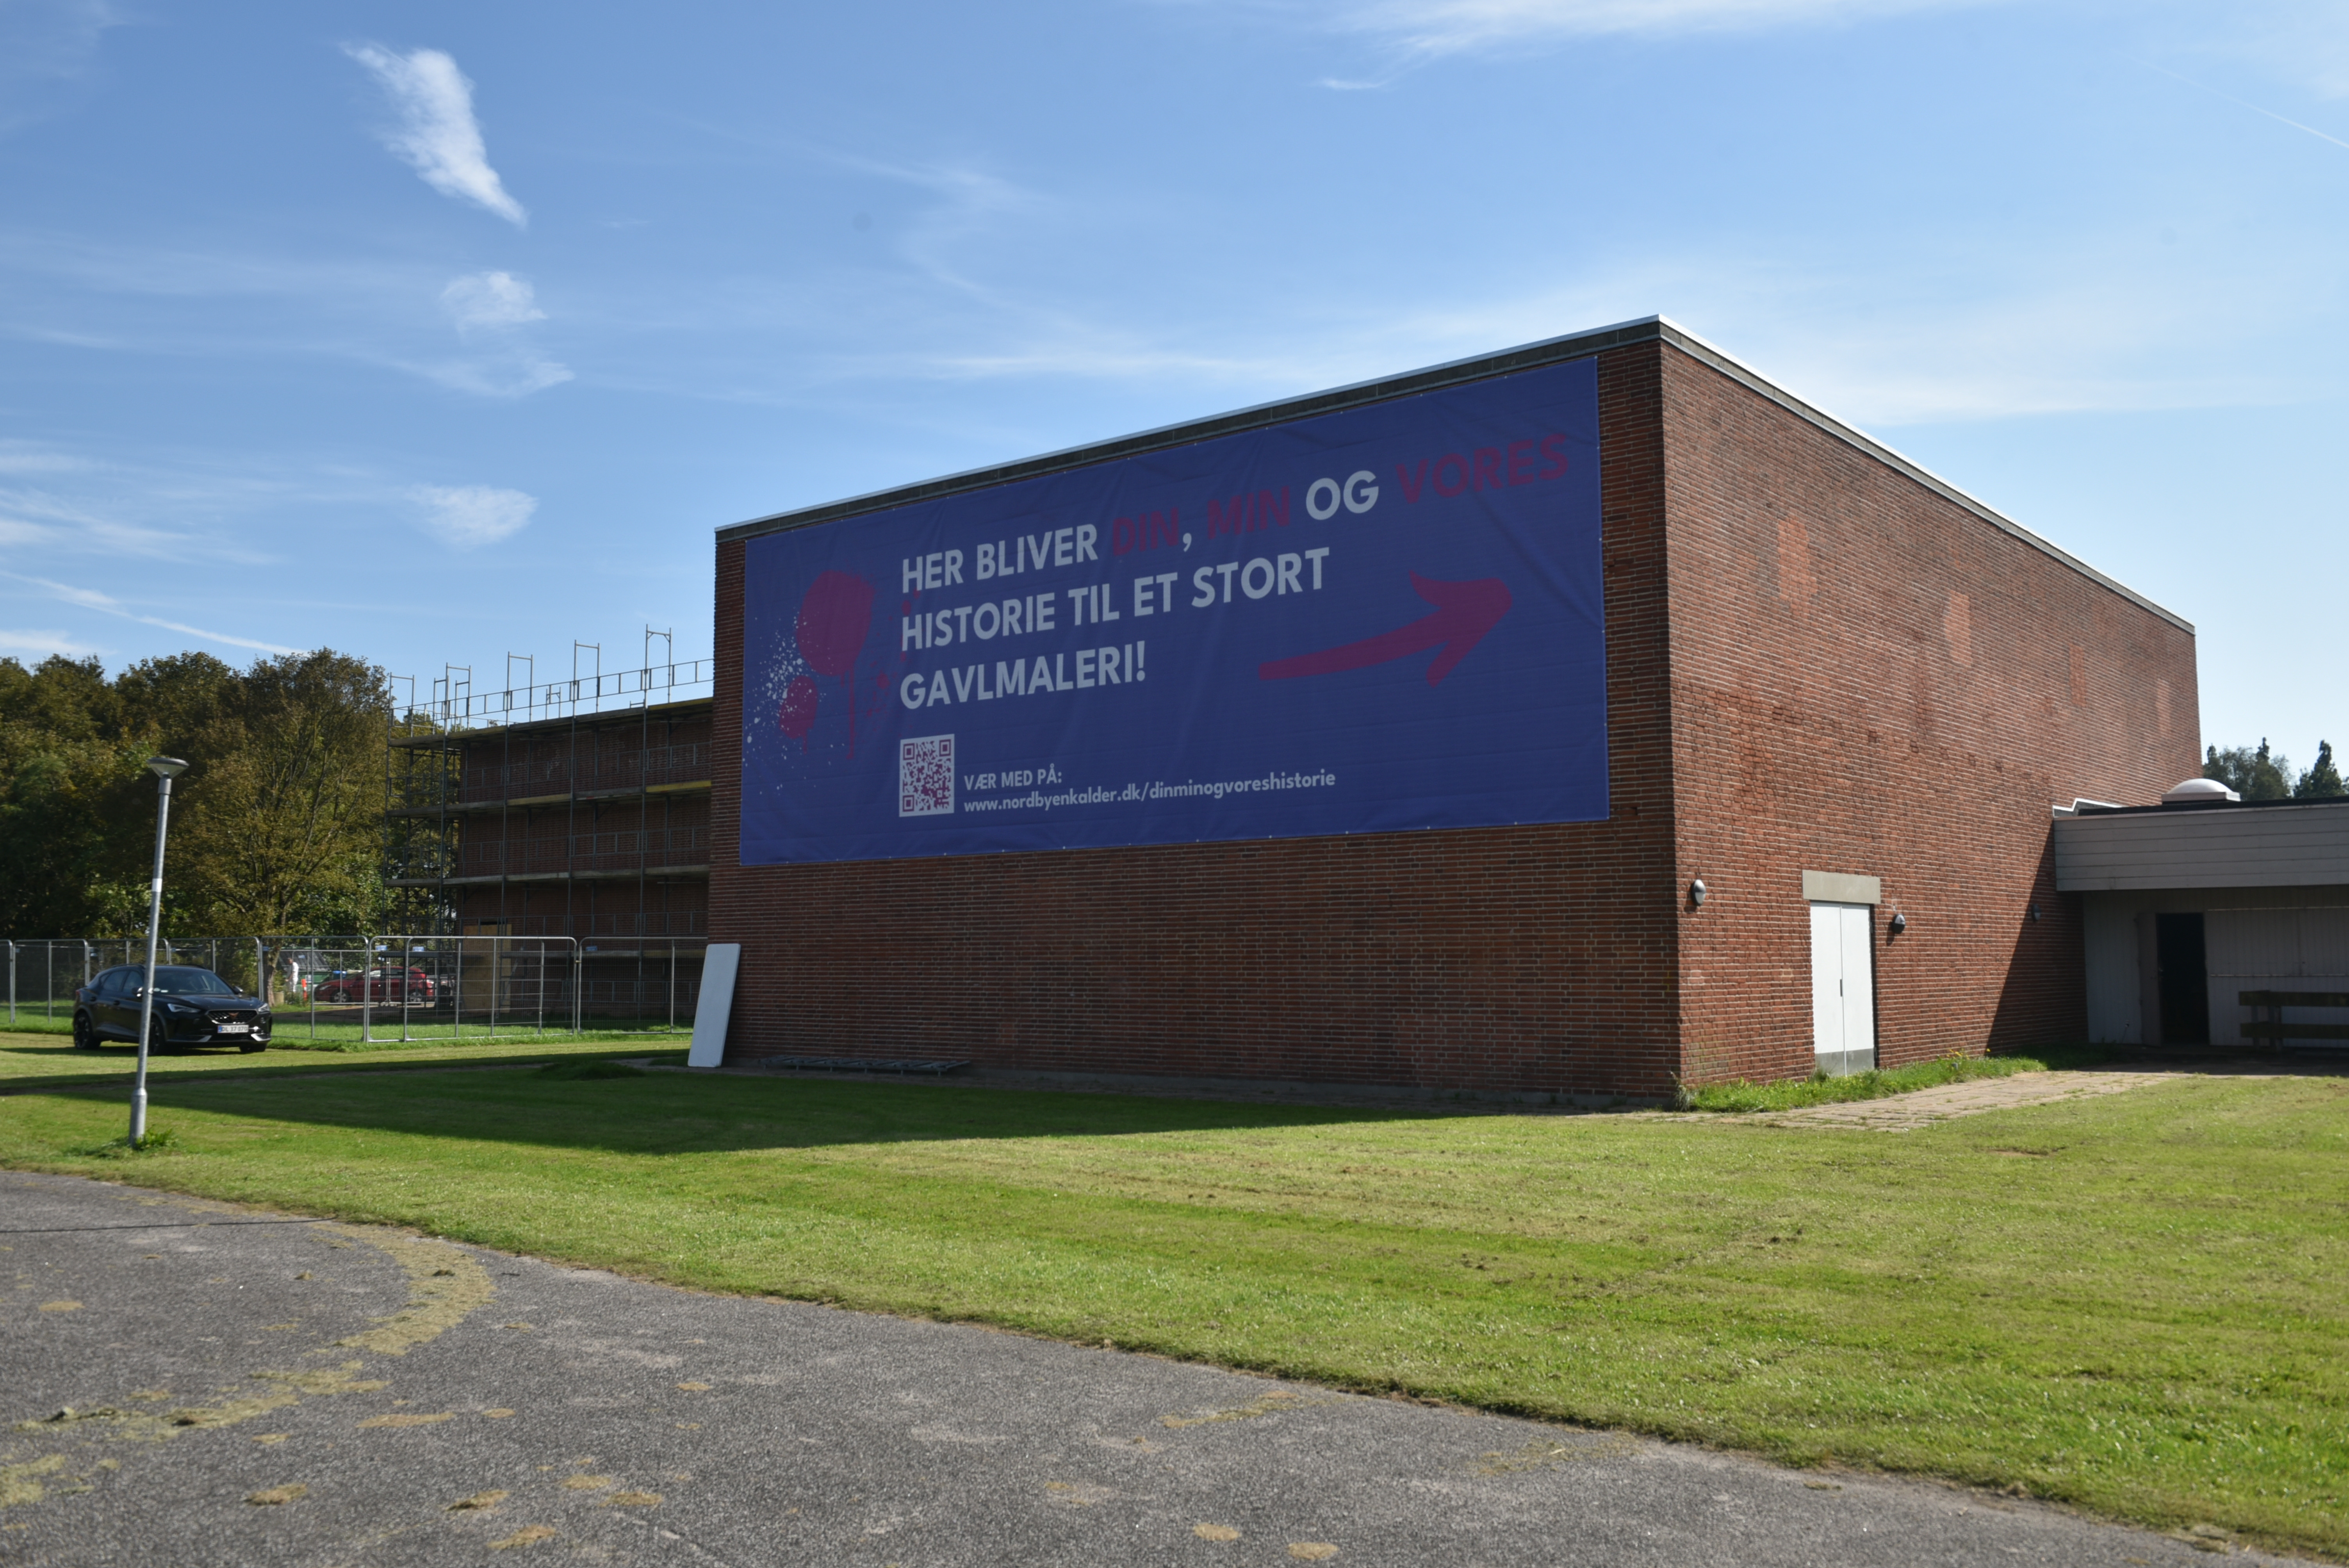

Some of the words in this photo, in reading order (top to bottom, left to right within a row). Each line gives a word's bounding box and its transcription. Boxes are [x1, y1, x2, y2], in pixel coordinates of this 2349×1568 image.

[902, 549, 964, 593] HER
[976, 524, 1098, 580] BLIVER
[1207, 487, 1290, 540] MIN
[1305, 470, 1379, 520] OG
[1395, 433, 1568, 503] VORES
[902, 592, 1055, 651] HISTORIE
[1068, 583, 1120, 626] TIL
[1134, 572, 1178, 617] ET
[1191, 547, 1330, 608] STORT
[900, 640, 1146, 709] GAVLMALERI!
[964, 773, 996, 790] VÆR
[1001, 770, 1033, 788] MED
[1037, 763, 1062, 785] PÅ:
[964, 768, 1336, 812] www.nordbyenkalder.dk/dinminogvoreshistorie
